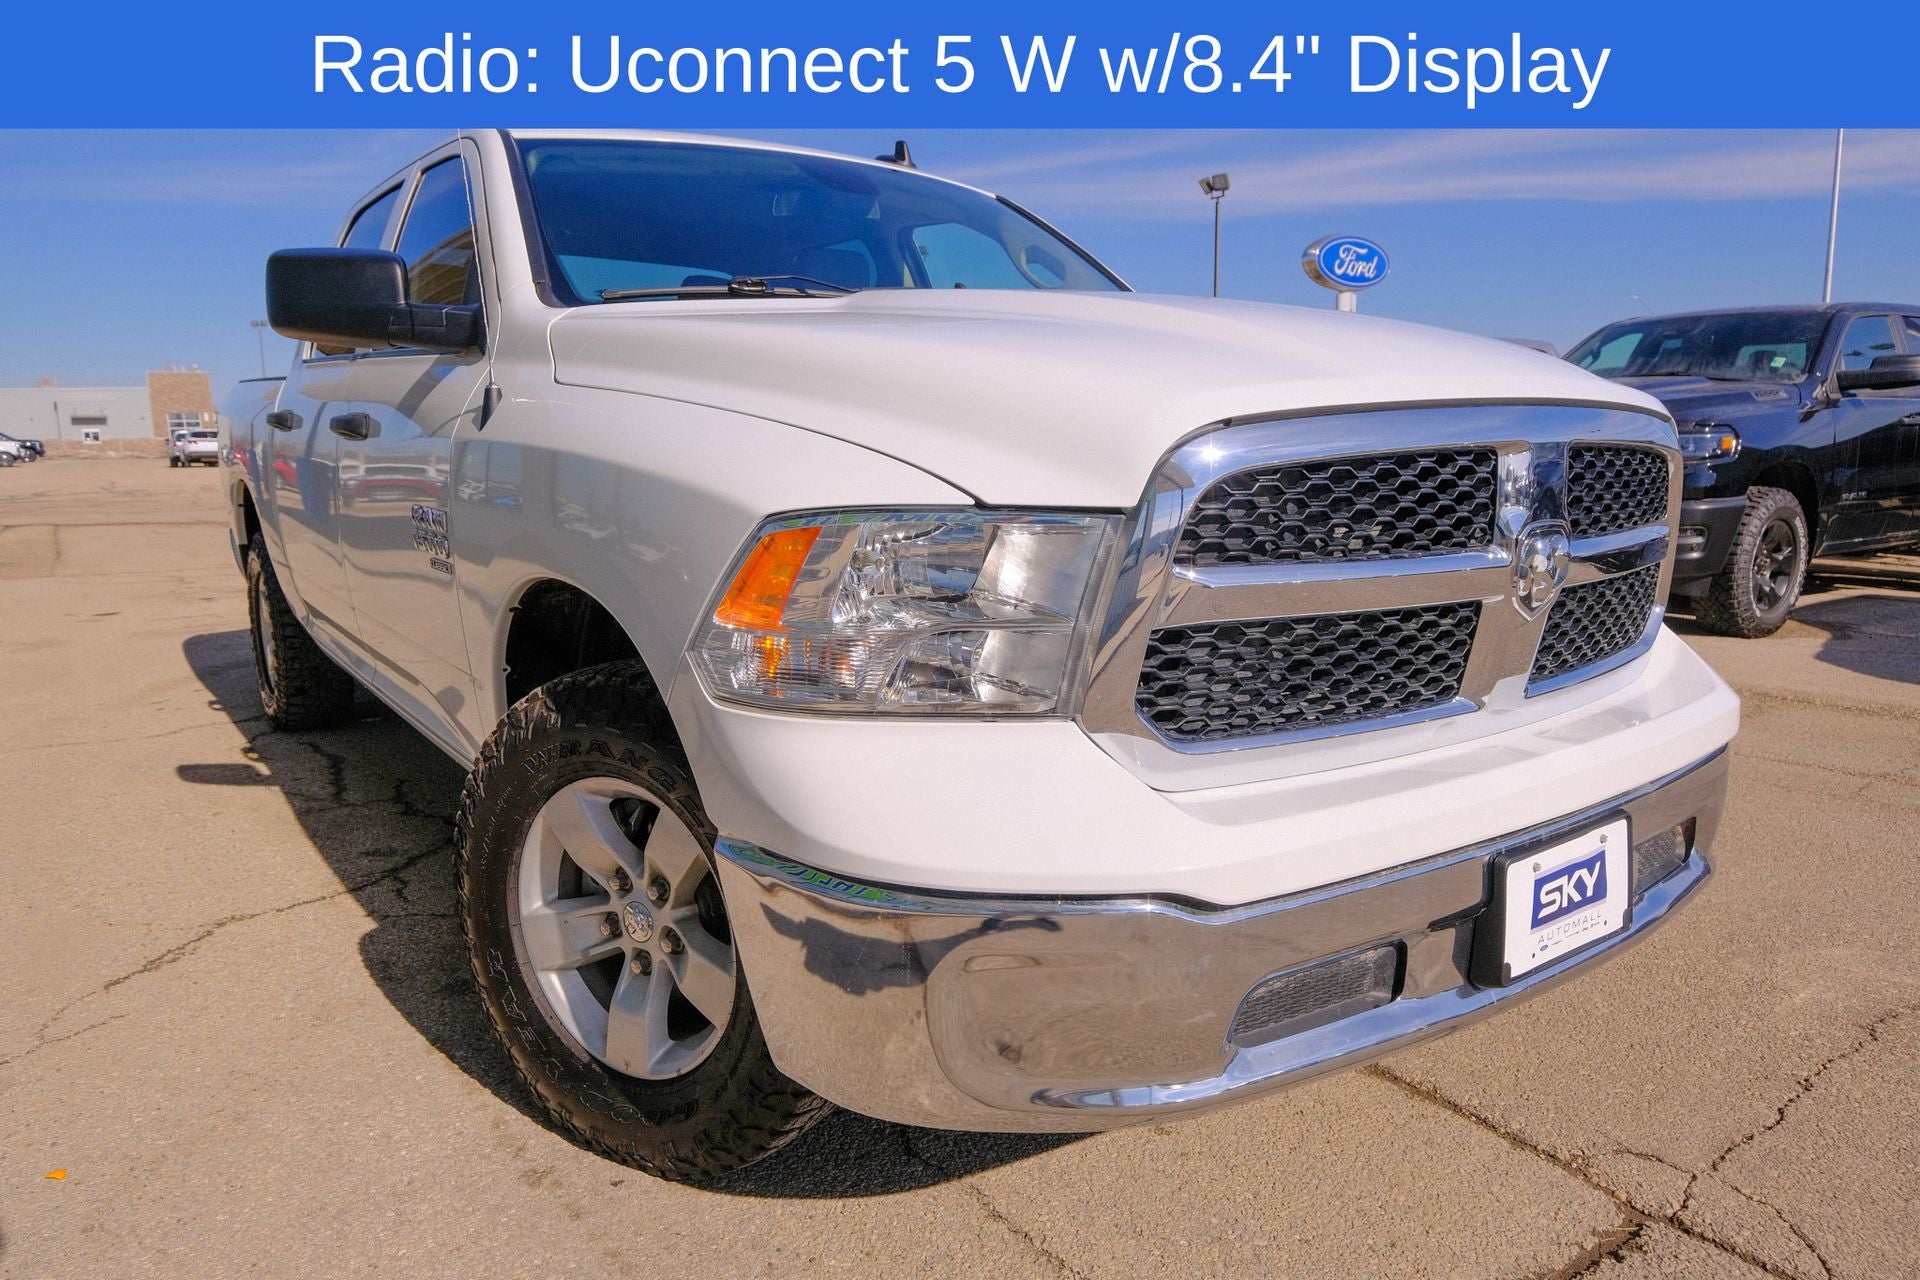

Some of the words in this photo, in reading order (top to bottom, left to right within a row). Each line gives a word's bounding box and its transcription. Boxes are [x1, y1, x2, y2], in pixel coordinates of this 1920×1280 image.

[1334, 244, 1378, 278] Ford
[1537, 860, 1601, 919] SKY
[1537, 910, 1602, 944] AUTOMALL
